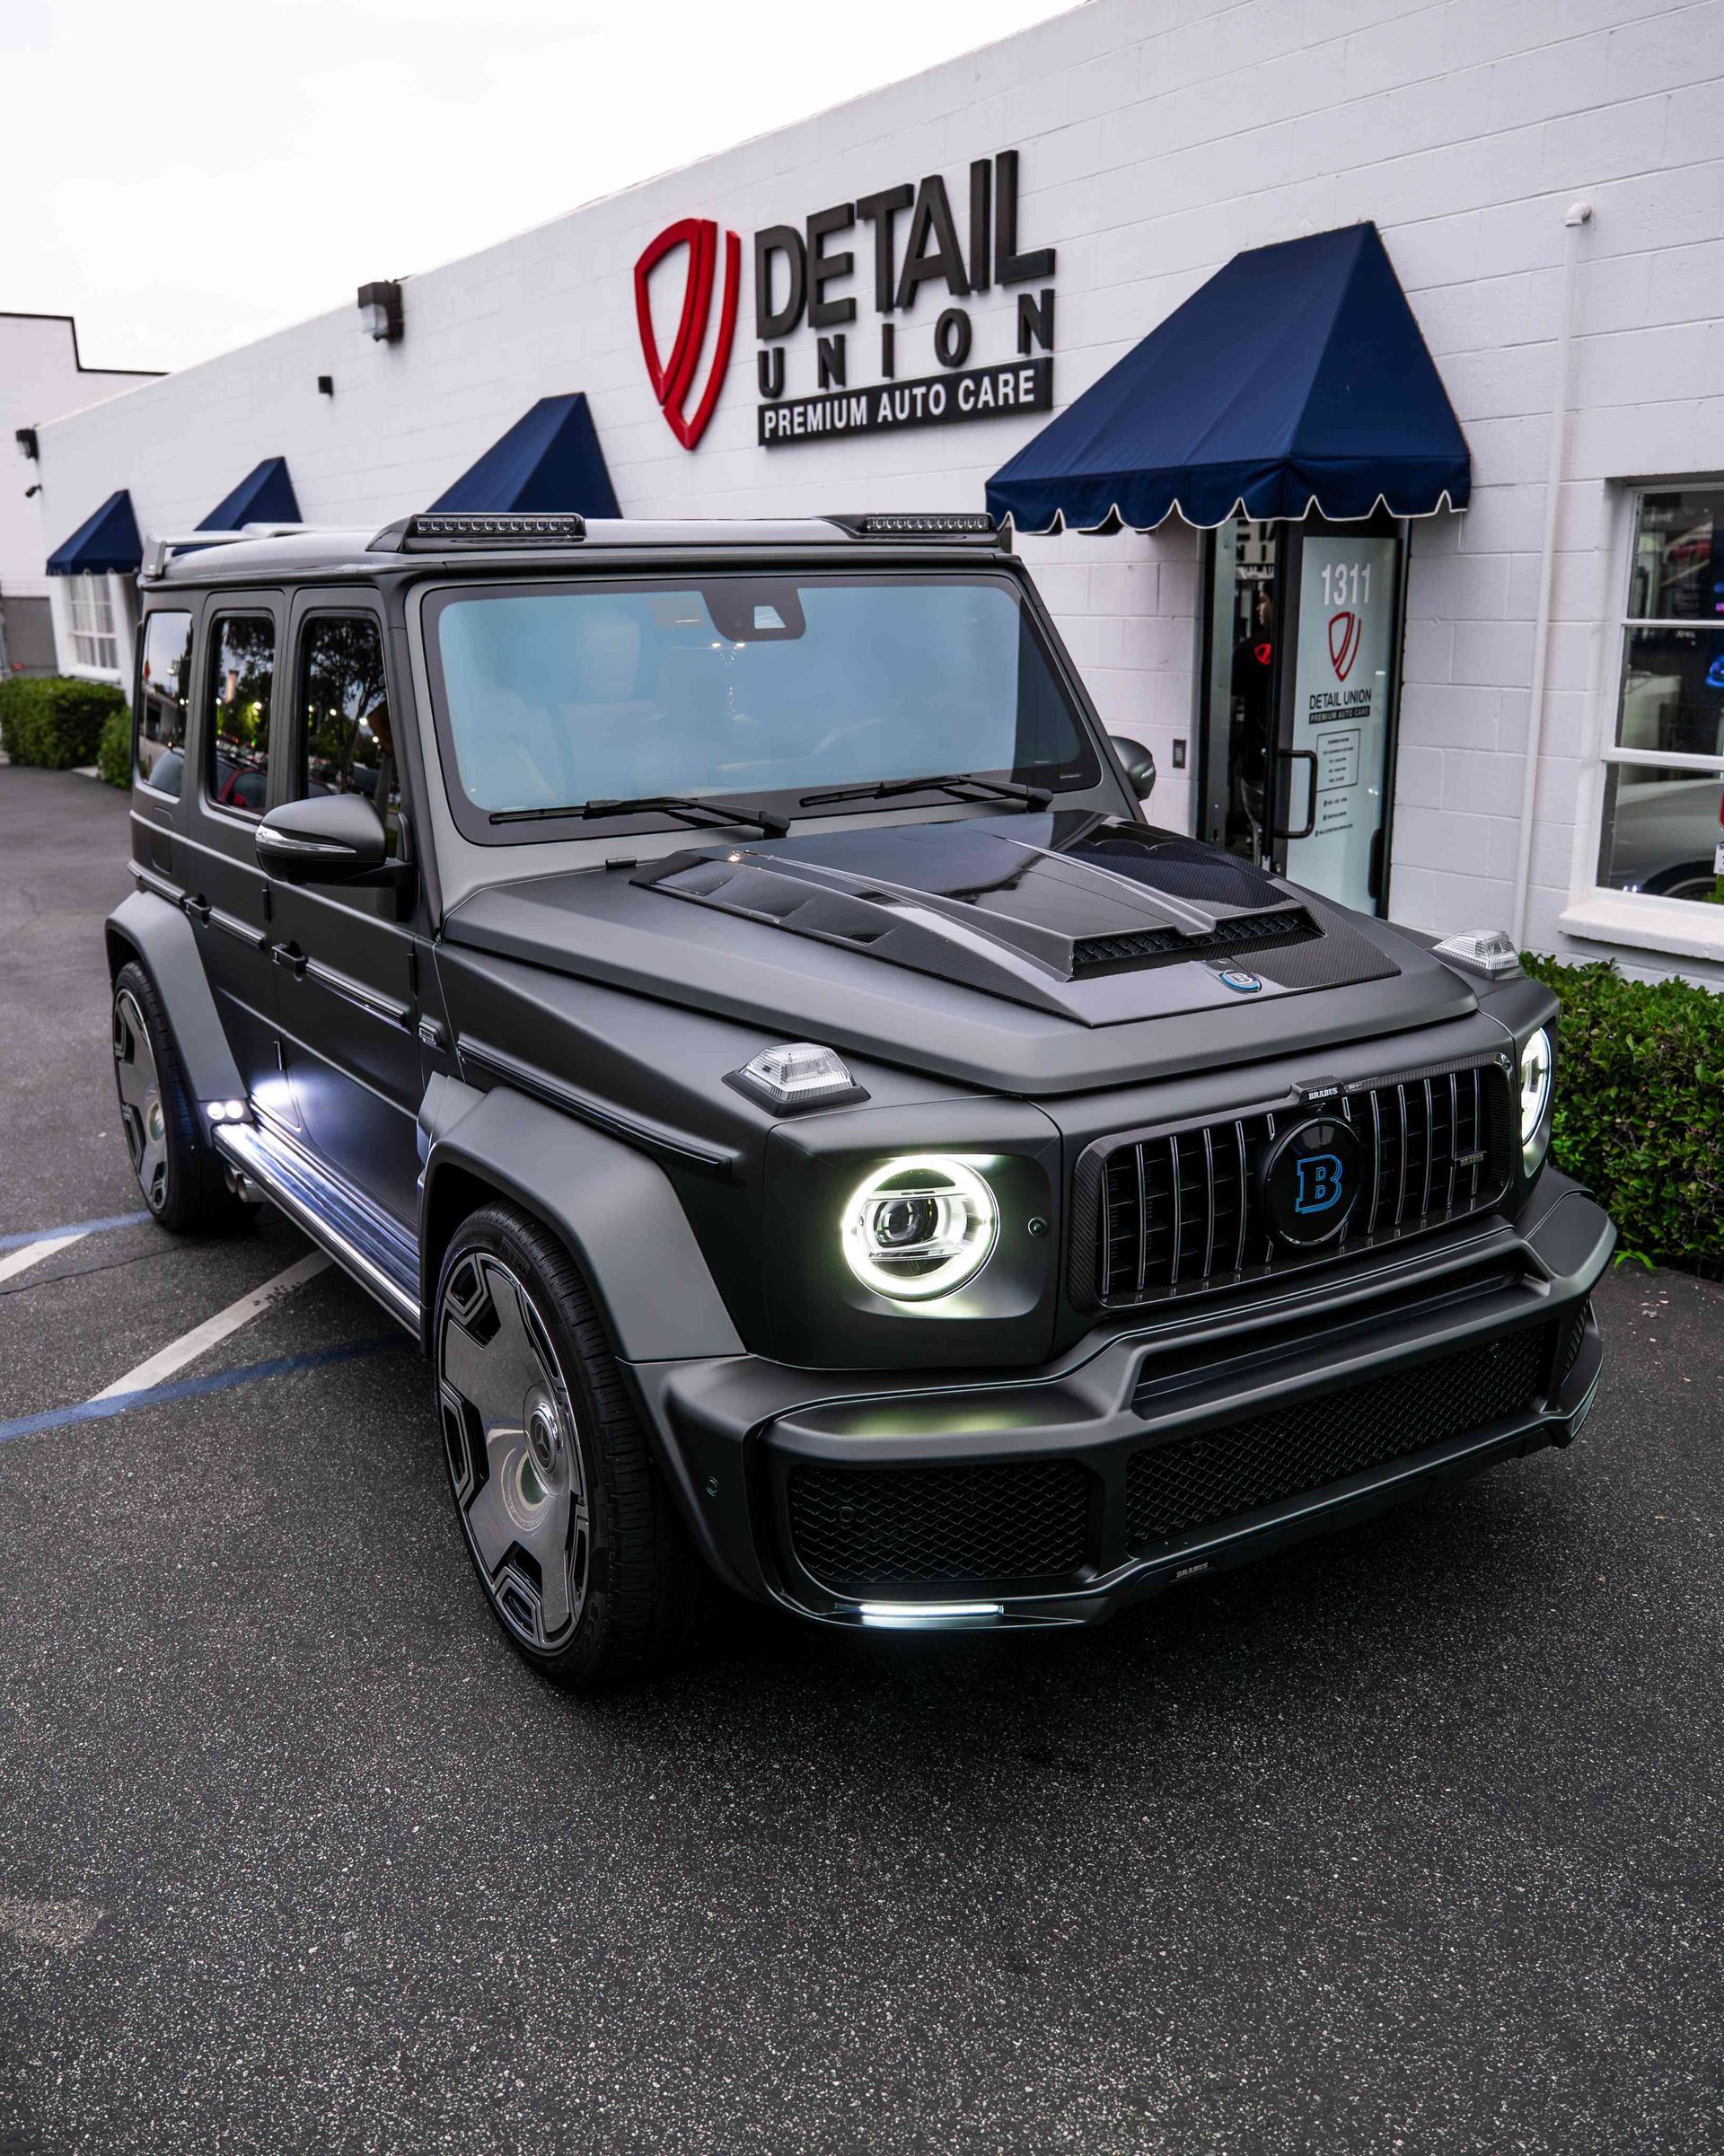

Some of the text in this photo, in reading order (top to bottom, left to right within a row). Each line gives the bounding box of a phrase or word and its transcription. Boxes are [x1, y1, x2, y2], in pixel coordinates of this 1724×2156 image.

[755, 150, 1056, 340] DETAIL
[758, 289, 1055, 398] UNION
[764, 369, 1034, 438] PREMIUM AUTO CARE
[1321, 563, 1371, 606] 1311
[1309, 688, 1372, 710] DETAIL UNION
[1308, 1087, 1338, 1100] BRABUS
[1295, 1155, 1343, 1214] B
[1176, 1562, 1209, 1578] BRABUS
